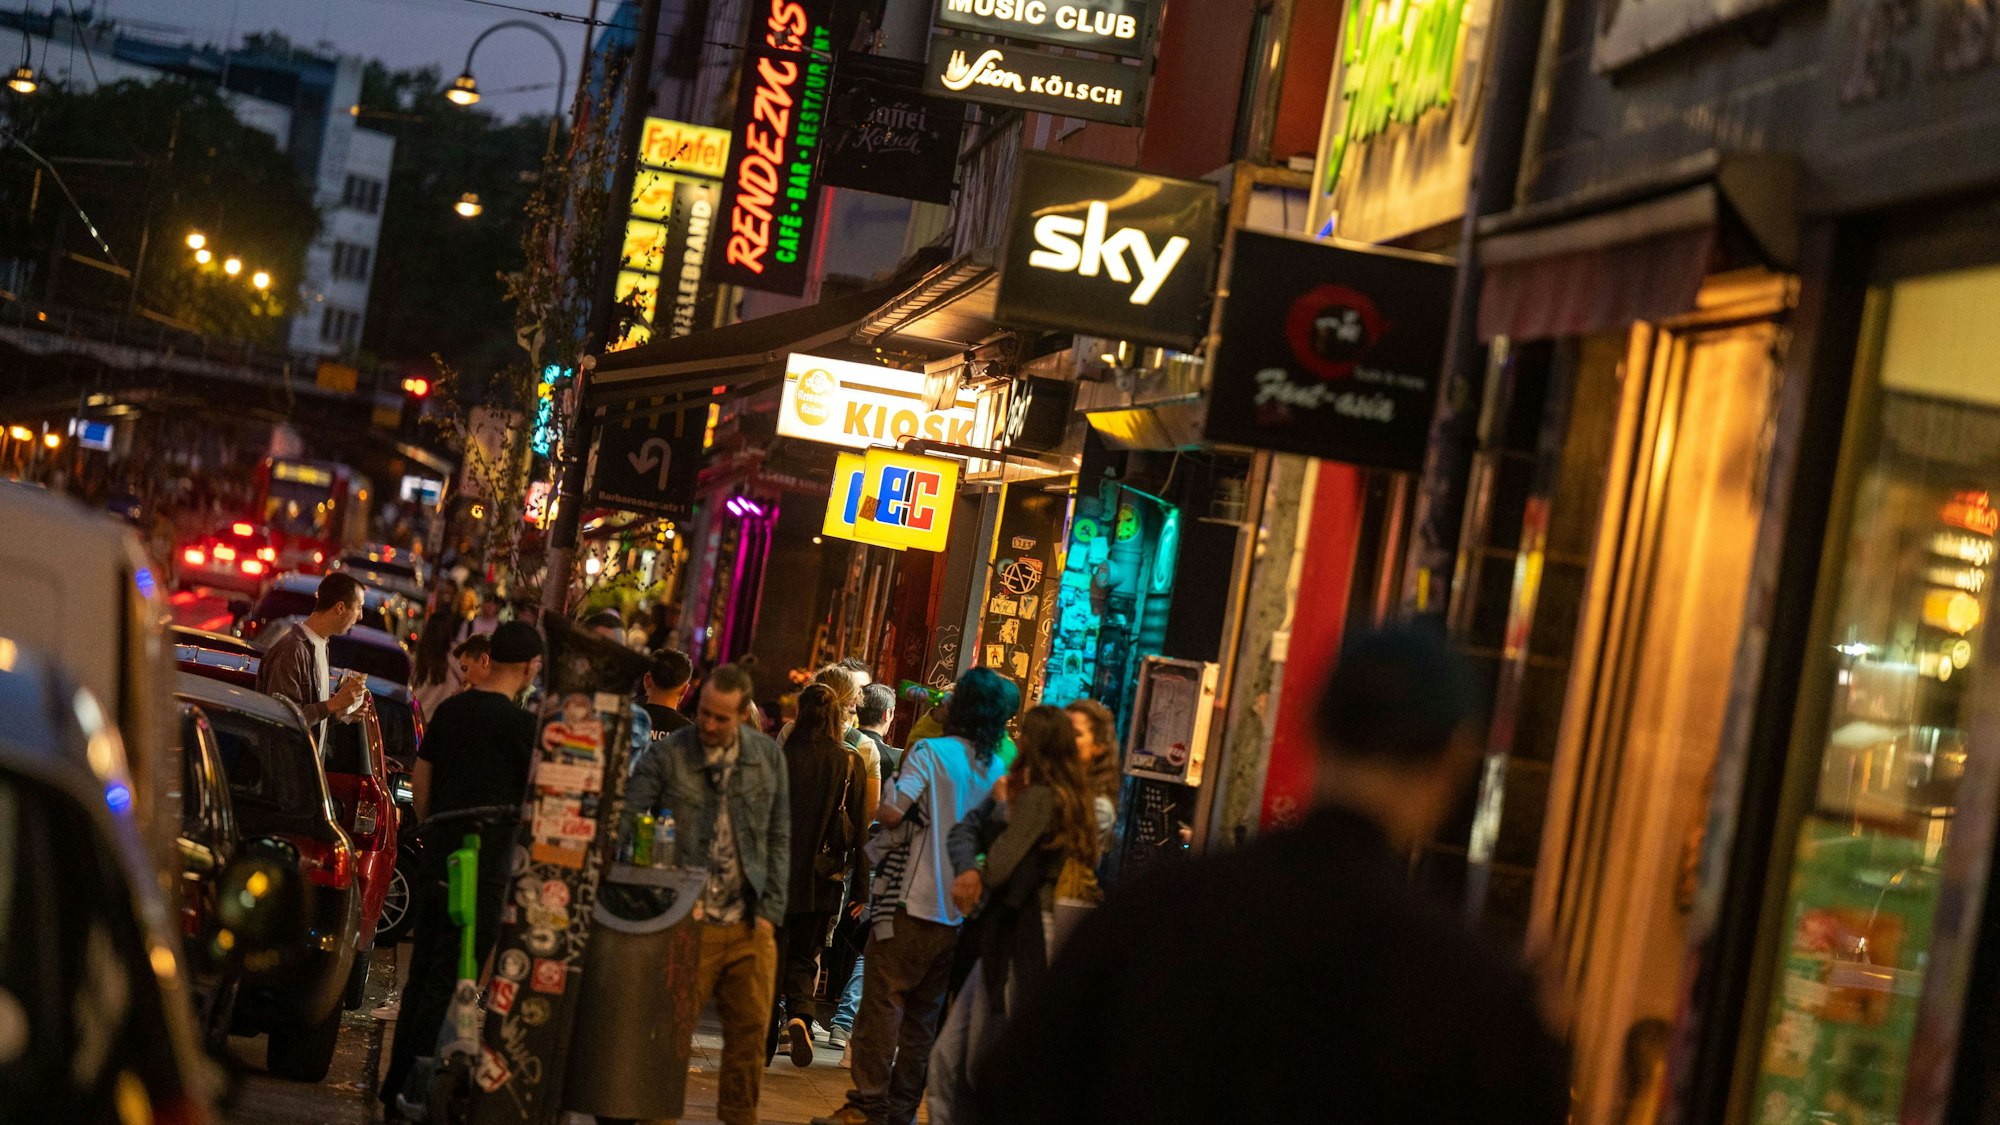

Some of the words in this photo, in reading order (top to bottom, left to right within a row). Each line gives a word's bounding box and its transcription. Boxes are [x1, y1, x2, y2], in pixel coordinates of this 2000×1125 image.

[1054, 5, 1137, 39] CLUB
[1029, 75, 1124, 106] KÖLSCH
[643, 124, 727, 168] Falafel
[786, 161, 812, 200] BAR
[774, 214, 803, 264] CAFÉ
[1028, 200, 1191, 306] sky
[843, 400, 974, 447] KIOSK
